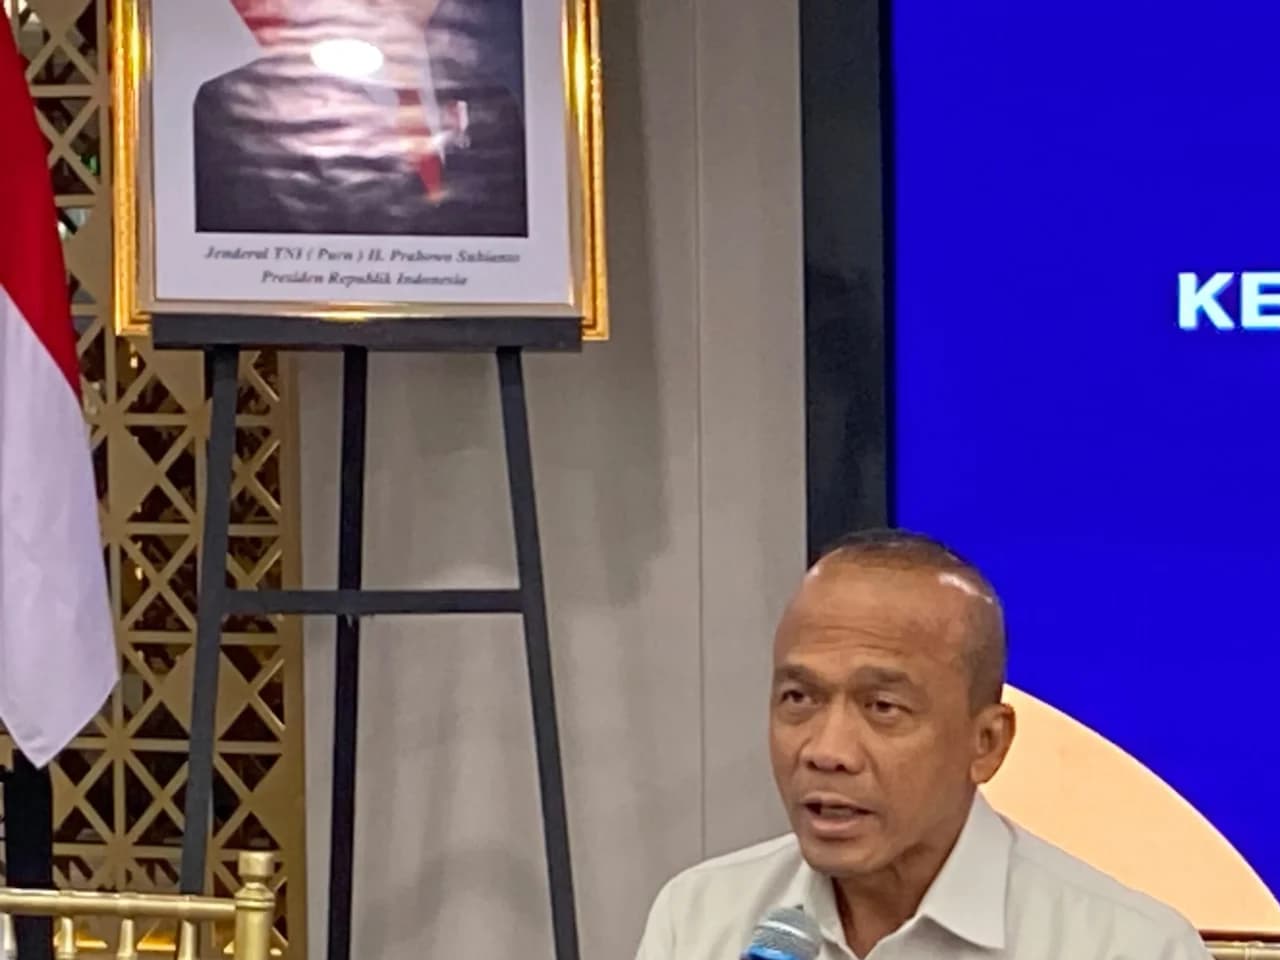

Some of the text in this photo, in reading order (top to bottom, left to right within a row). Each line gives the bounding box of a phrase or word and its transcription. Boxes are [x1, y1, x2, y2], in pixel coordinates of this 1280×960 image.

[205, 246, 269, 260] Jenderal
[274, 247, 303, 260] TNI
[389, 249, 453, 263] Prabowo
[261, 270, 469, 289] Presiden Republik Indonesia
